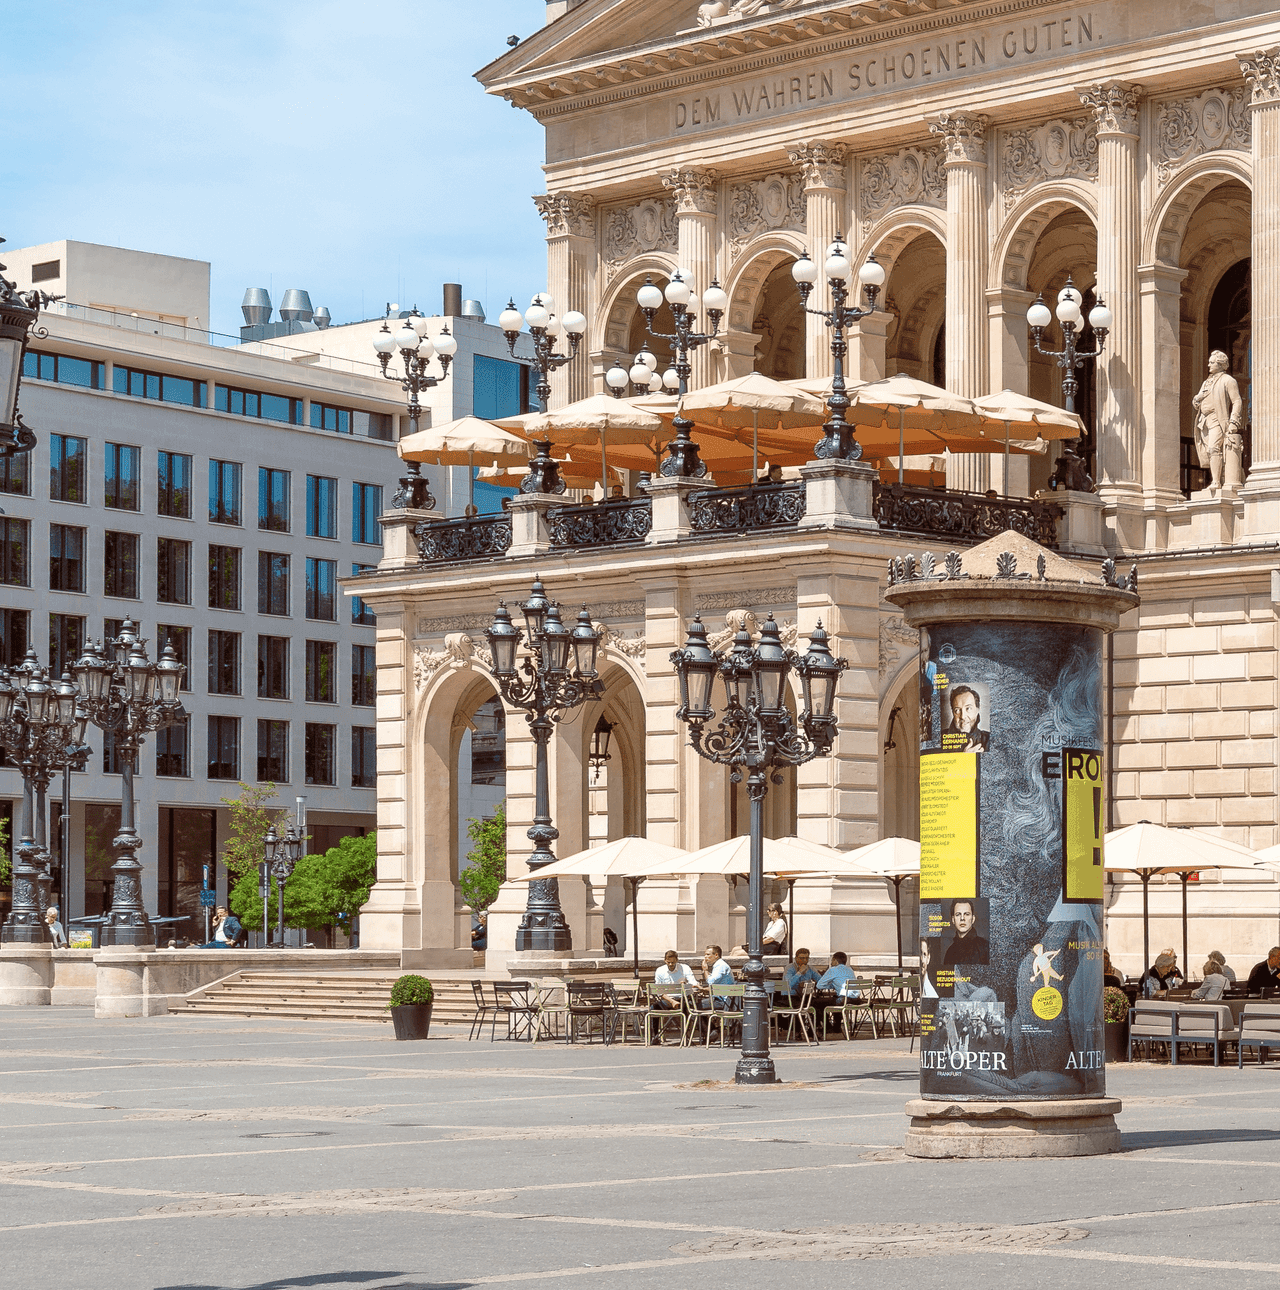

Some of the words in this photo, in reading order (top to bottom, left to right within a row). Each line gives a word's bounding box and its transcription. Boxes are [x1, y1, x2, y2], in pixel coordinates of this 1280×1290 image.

[676, 94, 721, 129] DEM
[733, 68, 834, 116] WAHREN
[848, 36, 986, 91] SCHOENEN
[1002, 12, 1103, 58] GUTEN.
[1042, 735, 1097, 747] MUSIKFEST
[950, 1050, 1008, 1070] OPER
[1065, 1051, 1101, 1069] ALTE
